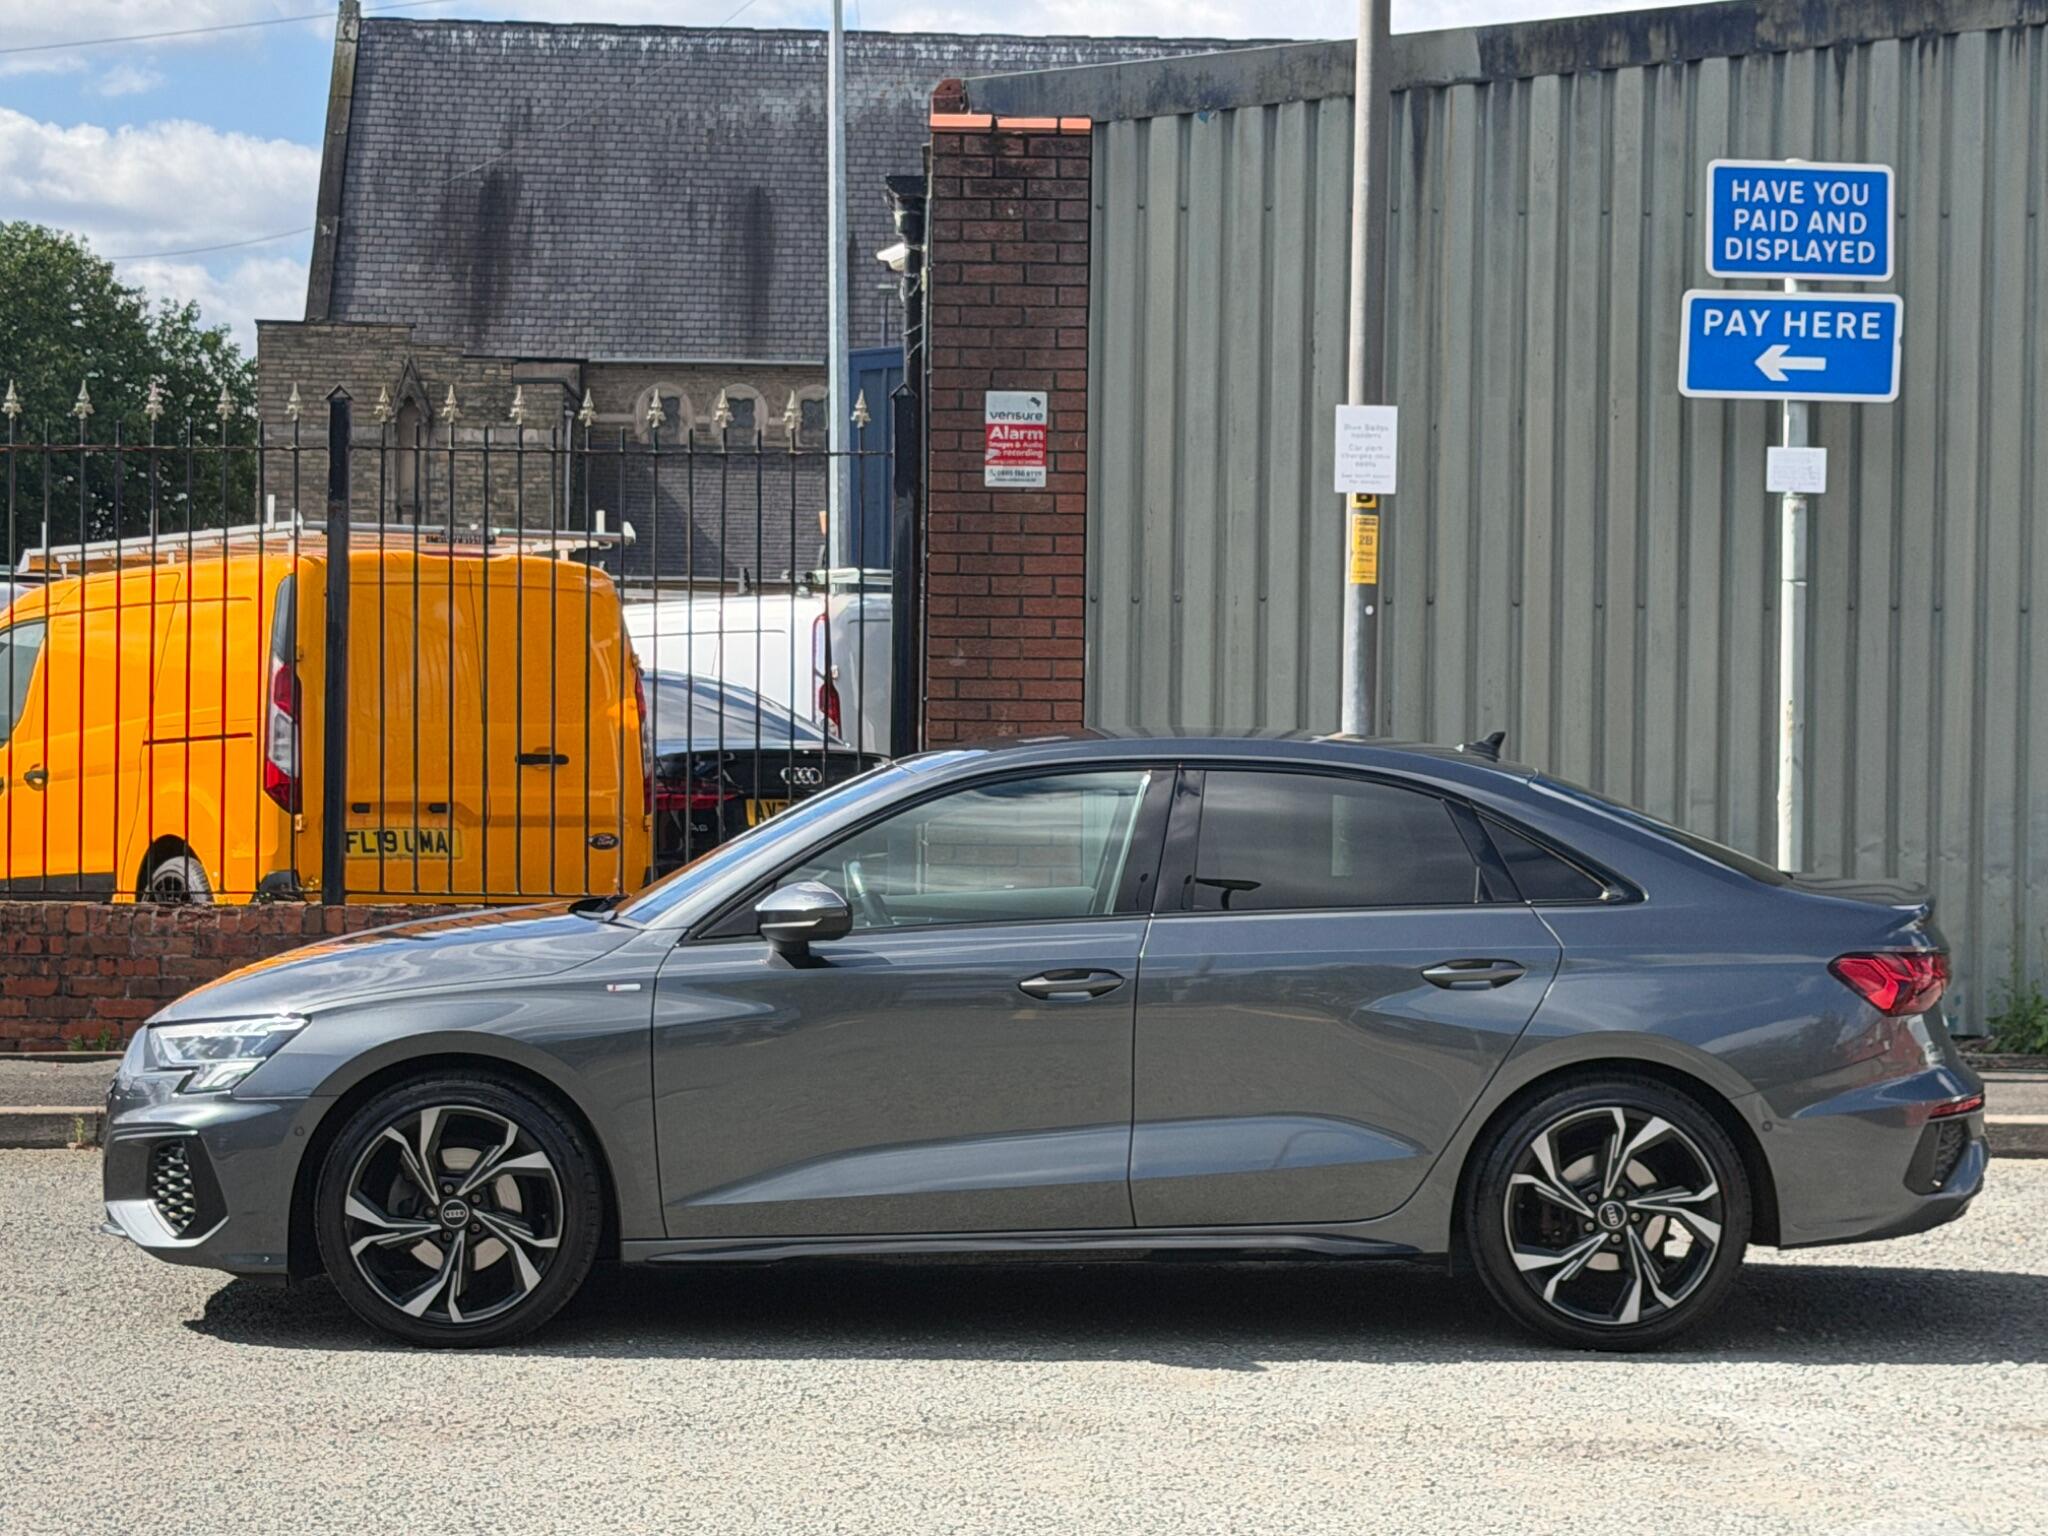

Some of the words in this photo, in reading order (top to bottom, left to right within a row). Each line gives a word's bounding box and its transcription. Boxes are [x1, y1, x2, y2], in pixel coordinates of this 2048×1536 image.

[1731, 179, 1805, 204] HAVE
[1813, 181, 1869, 206] YOU
[1734, 208, 1799, 232] PAID
[1807, 211, 1867, 235] AND
[1725, 237, 1876, 264] DISPLAYED
[1703, 308, 1771, 337] PAY
[1783, 311, 1881, 340] HERE
[989, 425, 1043, 440] Alarm
[345, 830, 398, 853] FL19
[404, 831, 449, 853] UMA
